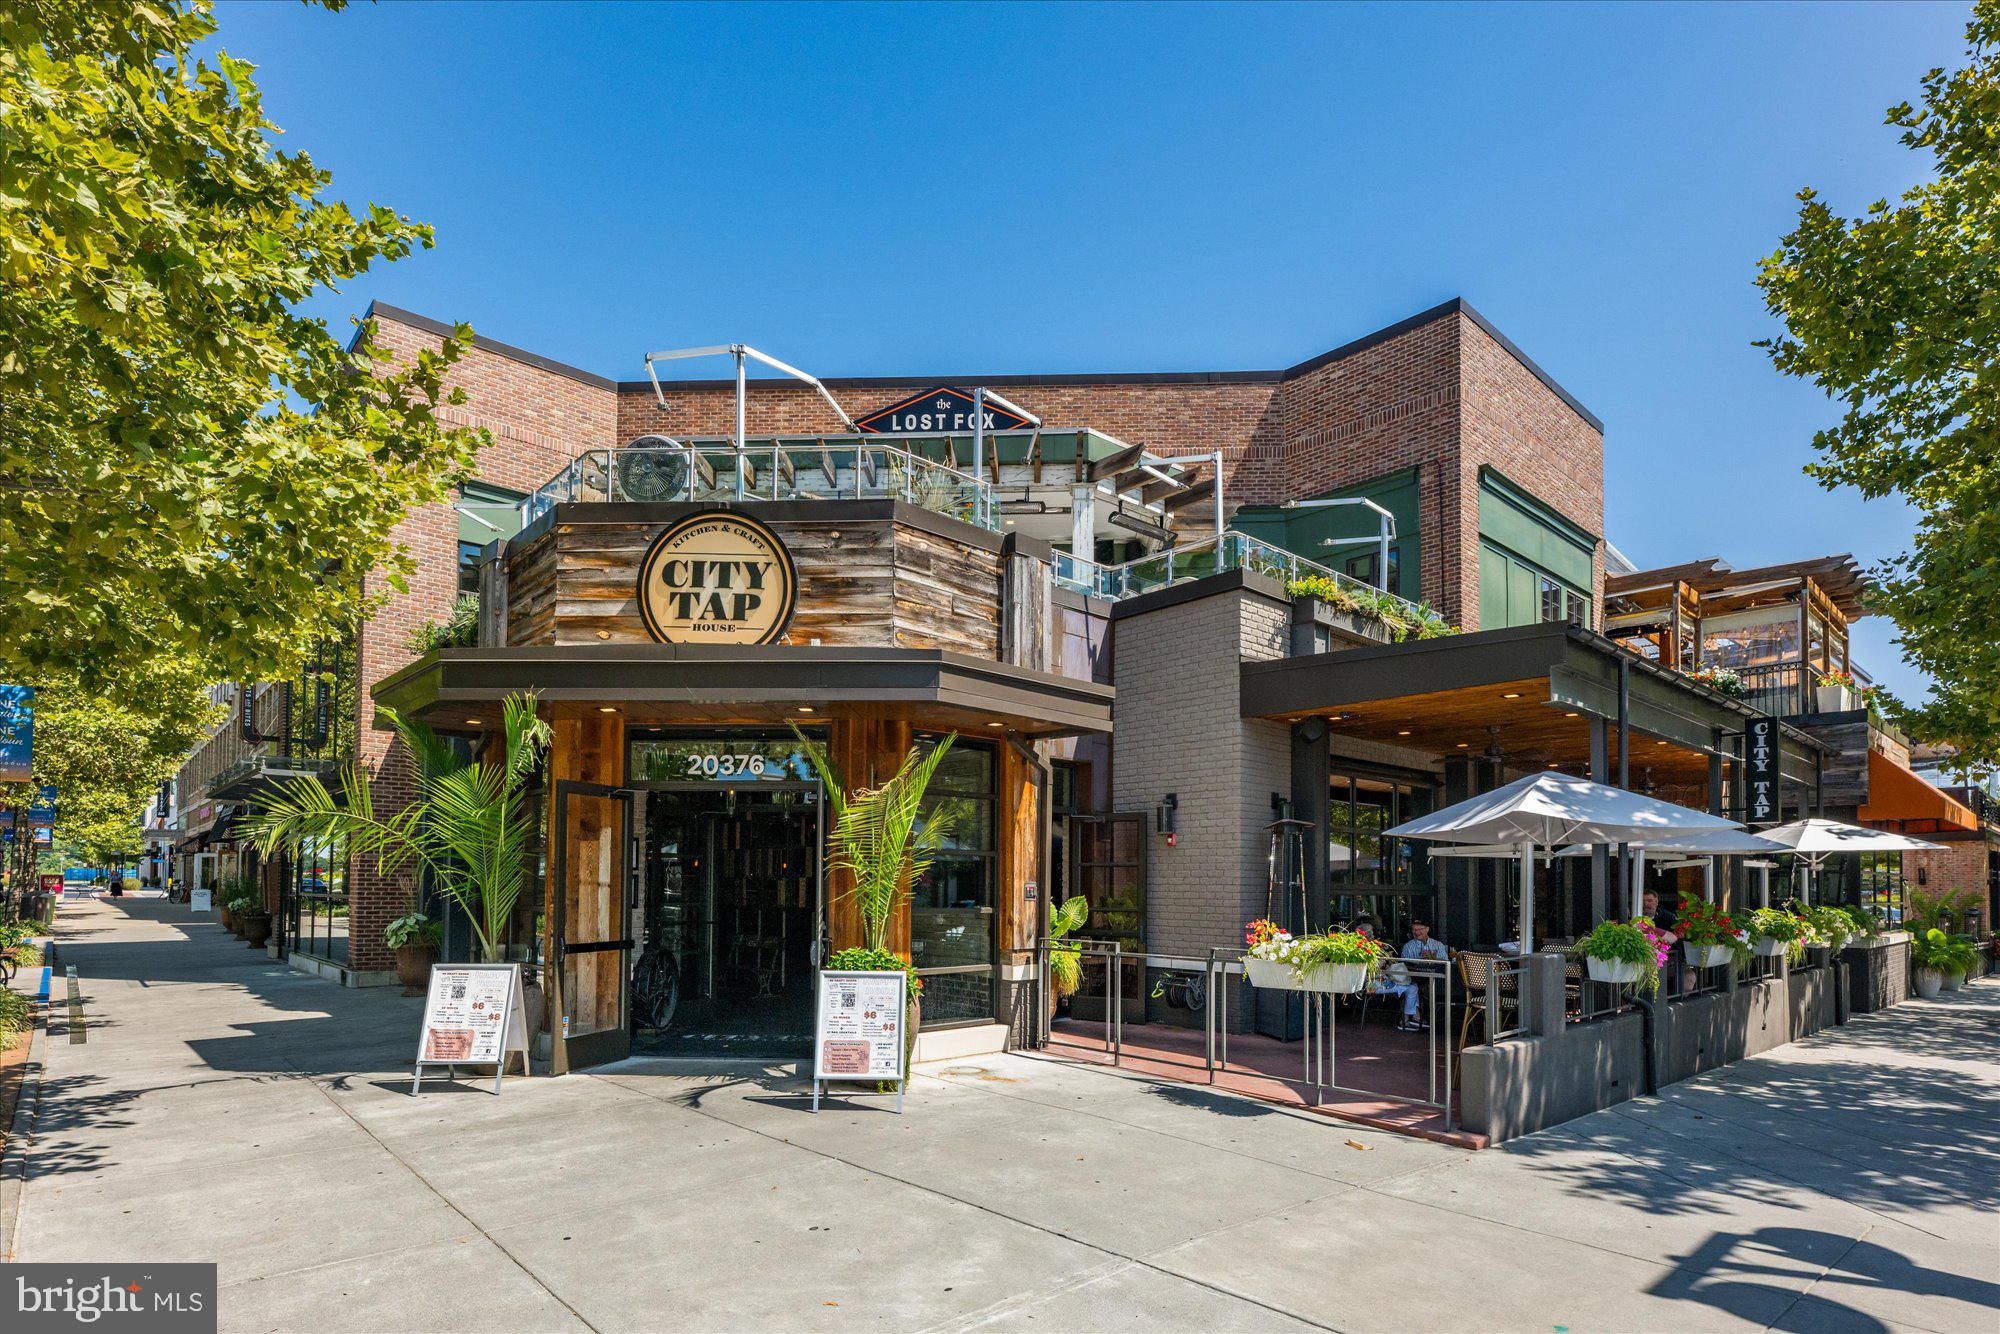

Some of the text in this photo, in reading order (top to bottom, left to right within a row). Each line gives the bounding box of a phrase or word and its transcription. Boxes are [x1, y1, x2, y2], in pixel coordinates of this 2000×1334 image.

[936, 398, 951, 410] the
[891, 413, 946, 431] LOST
[672, 524, 766, 550] KITCHEN & CRAFT
[661, 559, 773, 589] CITY
[669, 591, 762, 621] TAP
[692, 623, 736, 633] HOUSE
[687, 754, 765, 775] 20376
[1753, 722, 1770, 818] CITY TAP
[472, 1001, 485, 1010] $6
[488, 1013, 501, 1021] $8
[864, 1010, 877, 1019] $6
[882, 1022, 896, 1031] $8
